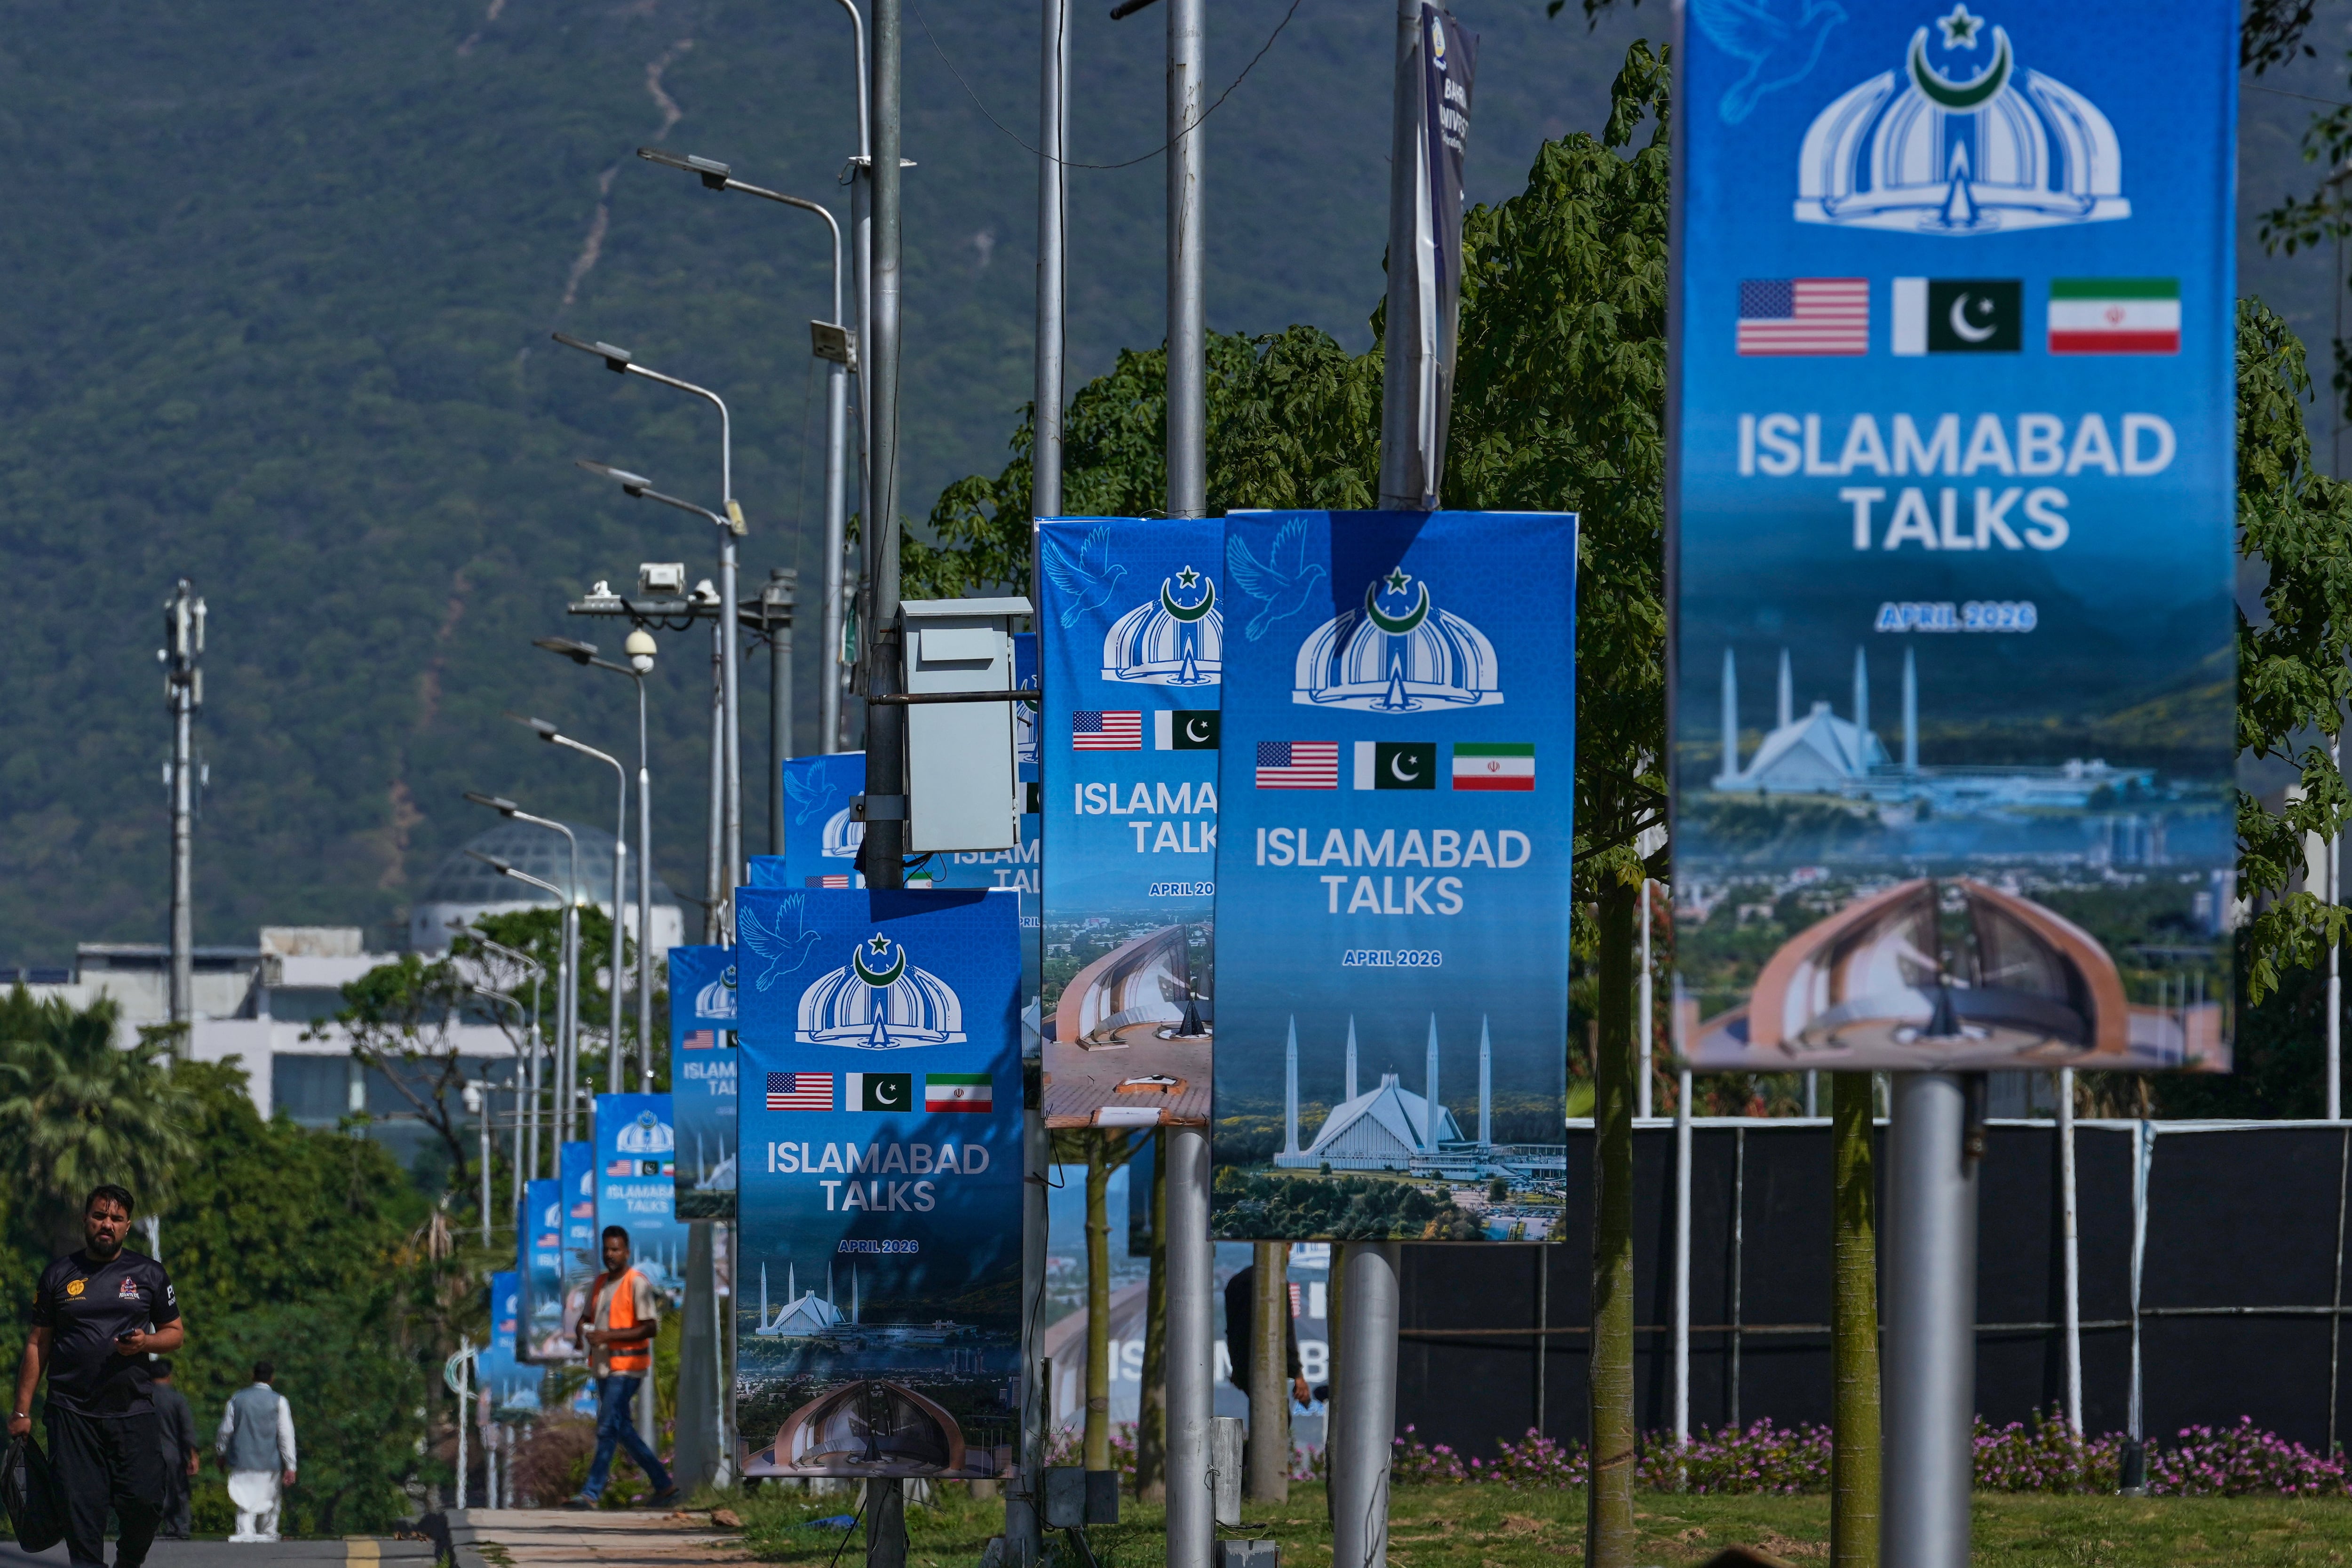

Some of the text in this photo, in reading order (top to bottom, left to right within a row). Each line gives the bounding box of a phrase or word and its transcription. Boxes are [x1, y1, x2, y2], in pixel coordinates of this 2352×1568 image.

[1738, 413, 2177, 477] ISLAMABAD
[1840, 486, 2070, 551] TALKS
[1875, 600, 2037, 632] APRIL 2026
[1075, 782, 1217, 814] ISLAMA
[1129, 821, 1217, 853] TALK
[1256, 828, 1531, 868] ISLAMABAD
[1149, 882, 1193, 897] APRIL
[1320, 876, 1463, 915] TALKS
[1342, 950, 1442, 967] APRIL 2026
[768, 1142, 990, 1175] ISLAMABAD
[627, 1200, 669, 1213] TALKS
[820, 1180, 935, 1211] TALKS
[838, 1240, 919, 1253] APRIL 2026
